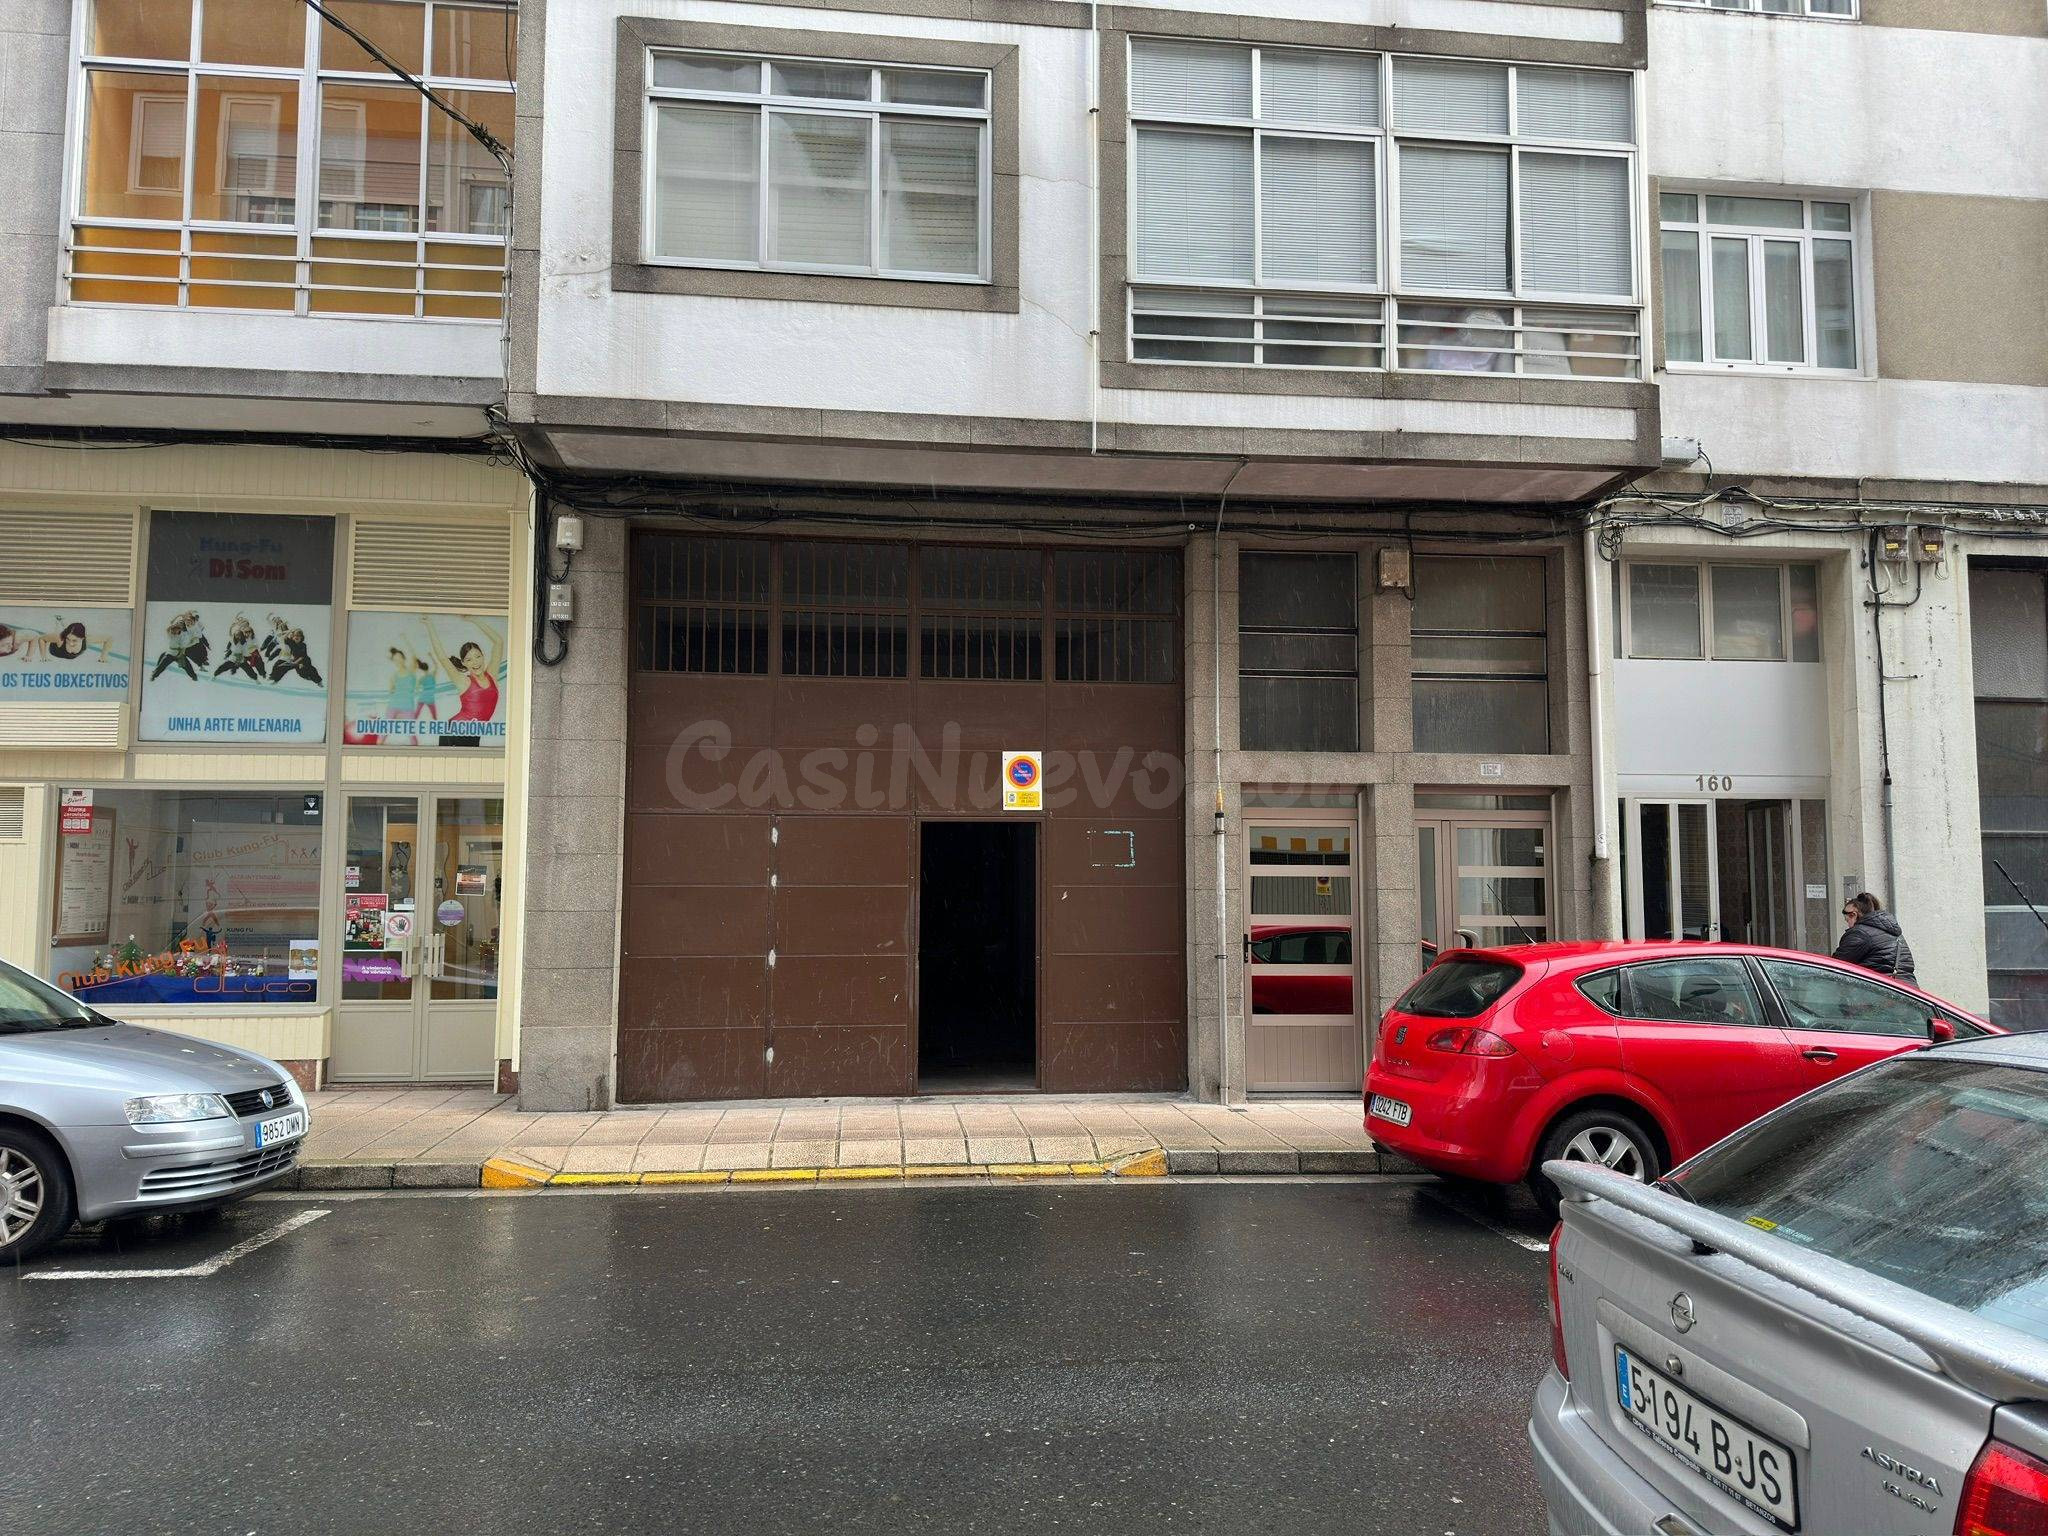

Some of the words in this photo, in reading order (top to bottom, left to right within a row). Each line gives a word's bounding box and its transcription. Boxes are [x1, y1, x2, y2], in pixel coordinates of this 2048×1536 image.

[237, 558, 288, 580] Som
[2, 672, 17, 688] OS
[21, 672, 51, 688] TEUS
[54, 673, 129, 688] OBXECTIVOS
[168, 716, 200, 731] UNHA
[204, 717, 234, 731] ARTE
[238, 717, 302, 732] MILENARIA
[419, 720, 426, 734] E
[1696, 774, 1732, 791] 160
[1393, 1102, 1408, 1120] FTB
[263, 1120, 284, 1142] 9852
[1621, 1383, 1628, 1398] E
[1631, 1365, 1700, 1455] 5194
[1711, 1418, 1782, 1506] BJS
[1860, 1446, 1943, 1498] ASTRA
